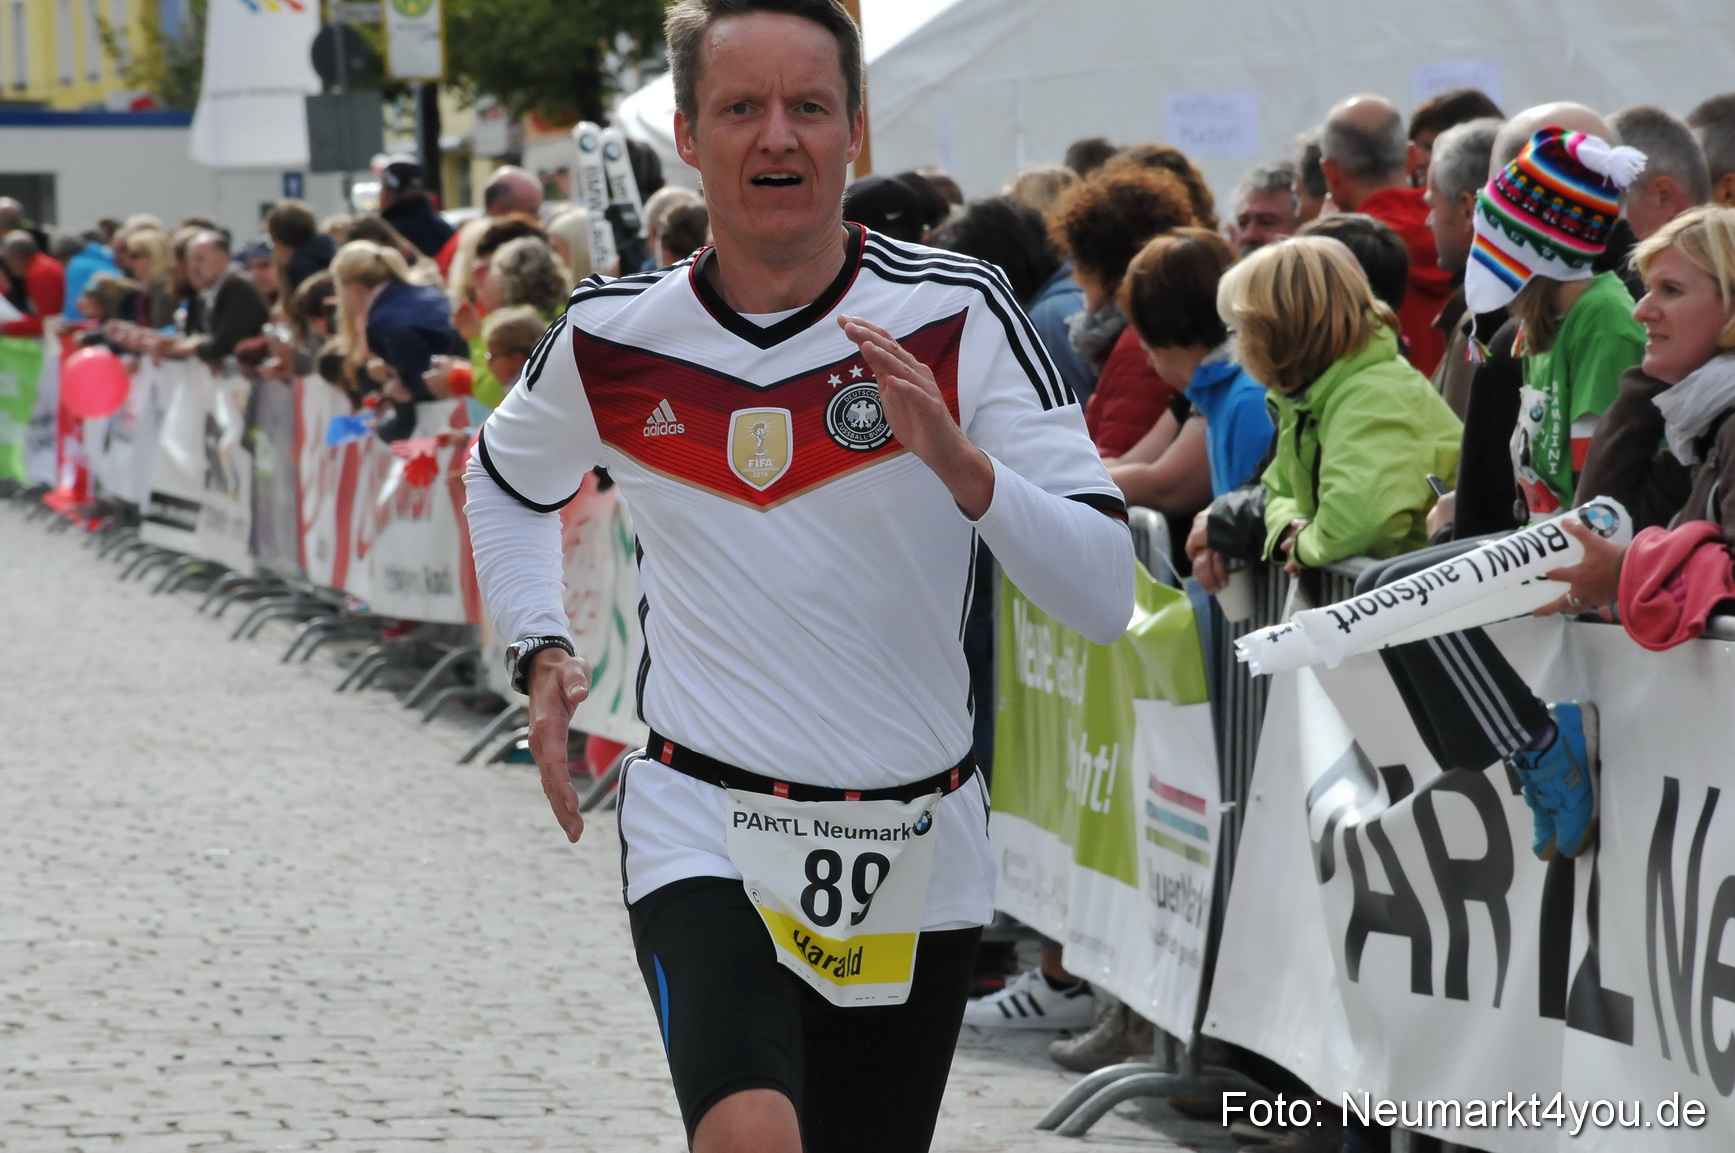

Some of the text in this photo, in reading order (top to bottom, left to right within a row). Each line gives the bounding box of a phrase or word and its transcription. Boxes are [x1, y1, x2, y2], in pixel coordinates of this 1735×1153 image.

[643, 421, 685, 437] adidas
[1548, 381, 1562, 475] BAMBINI
[748, 458, 773, 468] FIFA
[752, 471, 768, 481] 2014
[1326, 523, 1568, 634] BMW Laufsport
[733, 811, 807, 836] PARTL
[800, 849, 890, 927] 89
